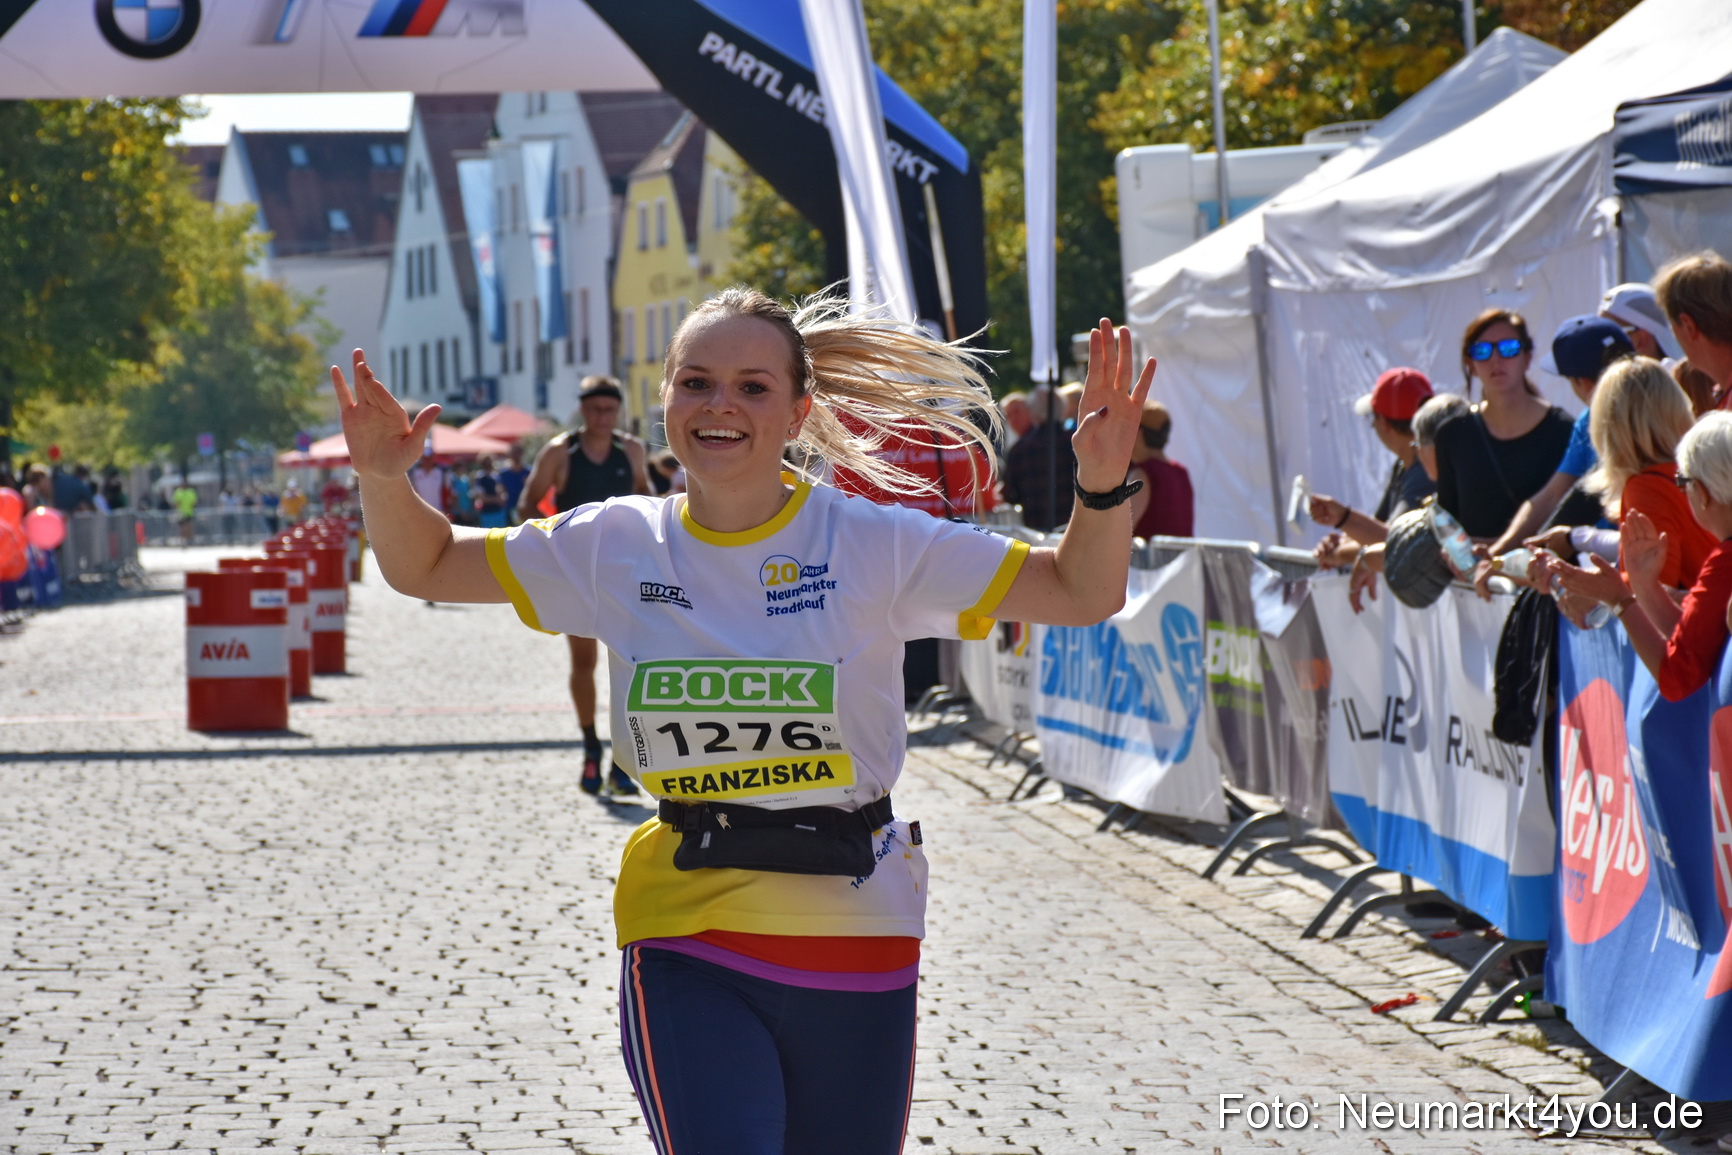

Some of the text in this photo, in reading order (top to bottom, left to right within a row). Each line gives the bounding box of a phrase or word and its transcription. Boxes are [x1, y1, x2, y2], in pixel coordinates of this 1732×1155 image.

[699, 31, 784, 100] PARTL
[764, 563, 798, 586] 20
[640, 582, 691, 605] BOCK
[766, 579, 838, 602] Neumarkter
[766, 594, 825, 616] Stadtlauf
[644, 669, 813, 705] BOCK
[656, 721, 822, 757] 1276
[661, 760, 834, 795] FRANZISKA
